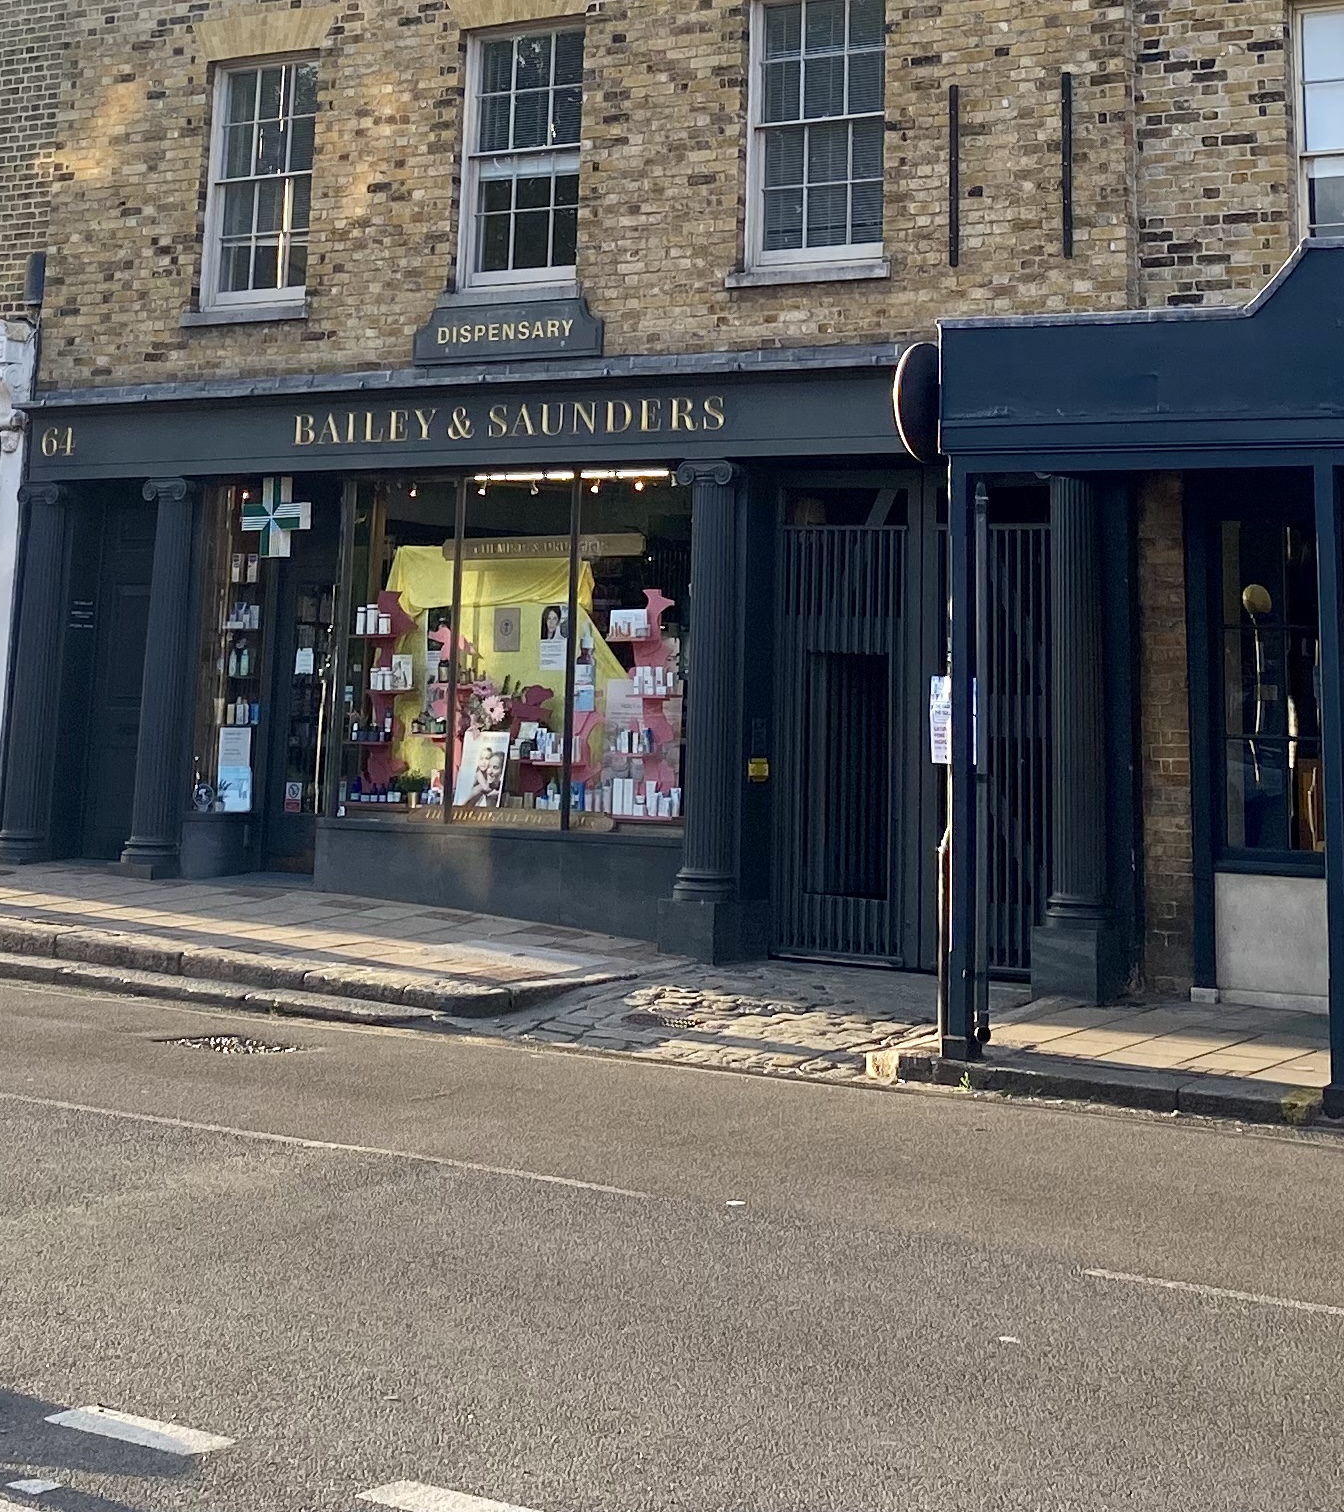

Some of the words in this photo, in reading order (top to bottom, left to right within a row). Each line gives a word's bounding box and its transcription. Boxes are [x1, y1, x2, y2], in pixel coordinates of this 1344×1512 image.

[437, 317, 575, 345] DISPENSARY
[292, 407, 439, 446] BAILEY
[447, 405, 475, 440] &
[487, 395, 726, 439] SAUNDERS
[40, 427, 76, 457] 64
